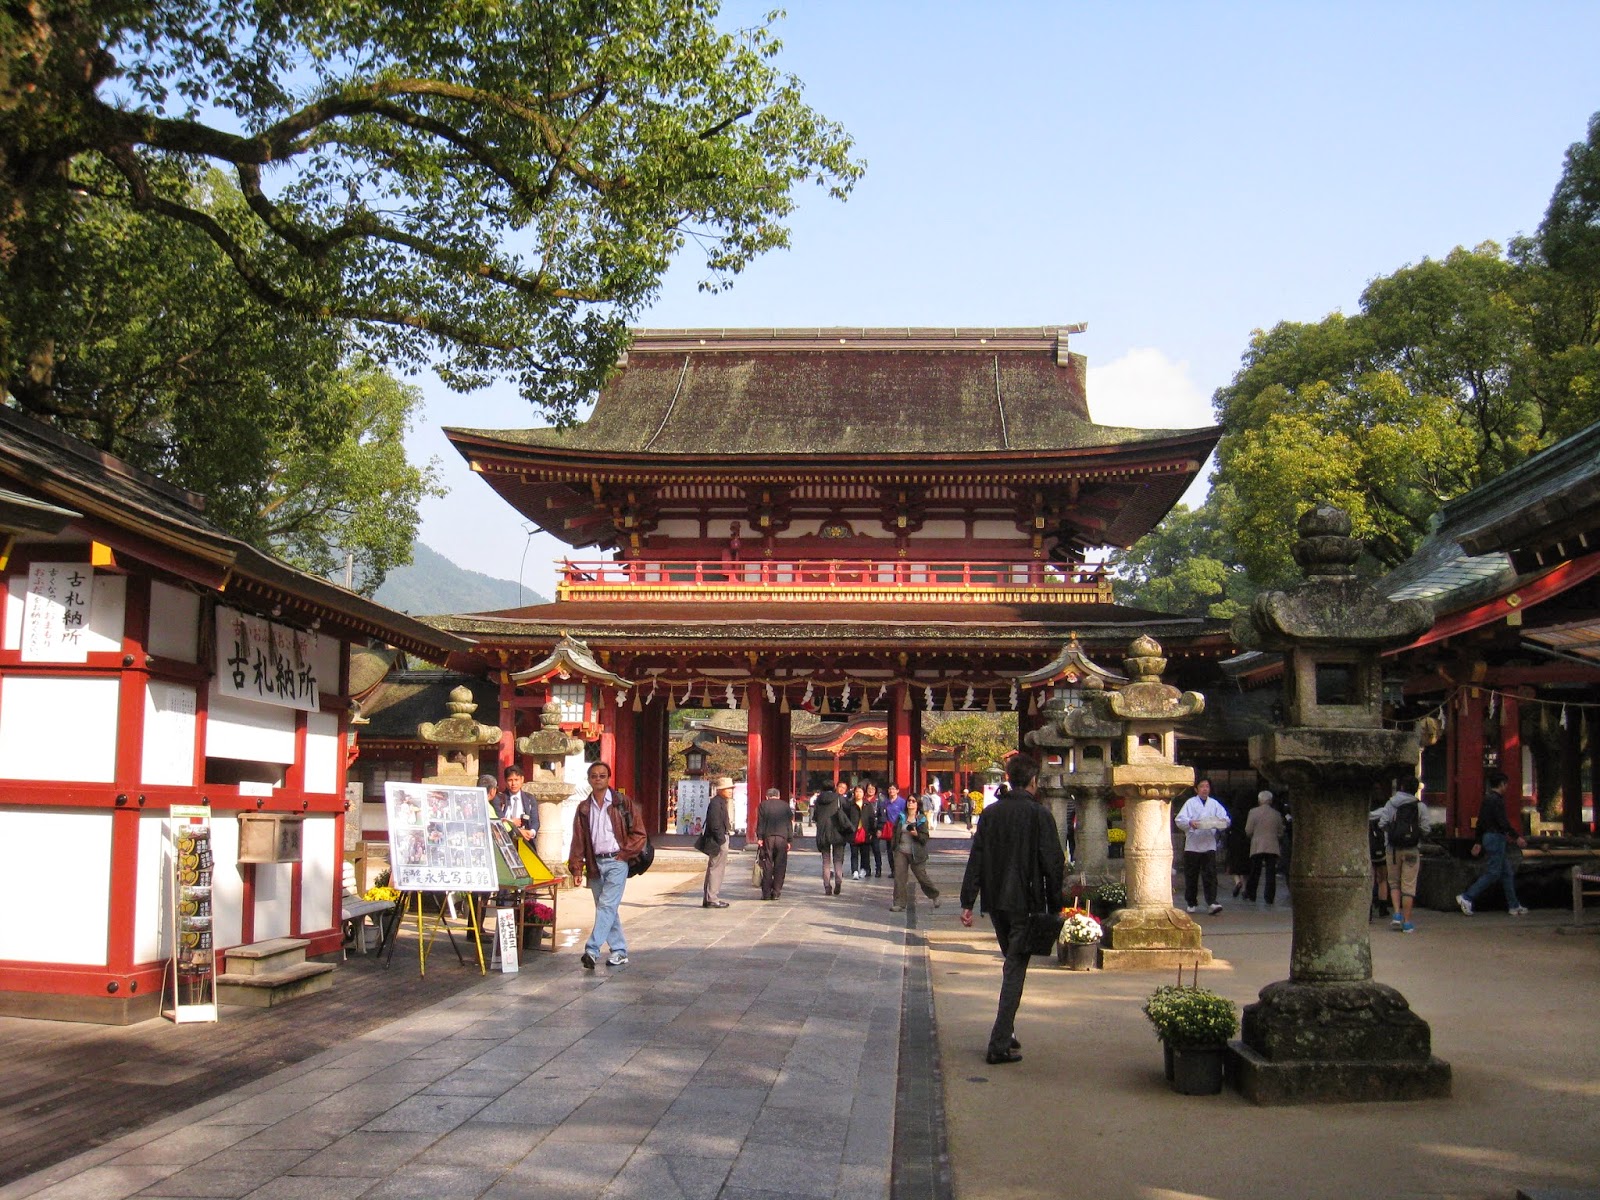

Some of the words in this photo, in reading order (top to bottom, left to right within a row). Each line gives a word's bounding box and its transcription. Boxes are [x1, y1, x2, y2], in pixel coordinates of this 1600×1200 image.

[61, 571, 86, 645] 古札納所
[227, 640, 317, 708] 古札納所
[424, 869, 489, 886] 永光写真館
